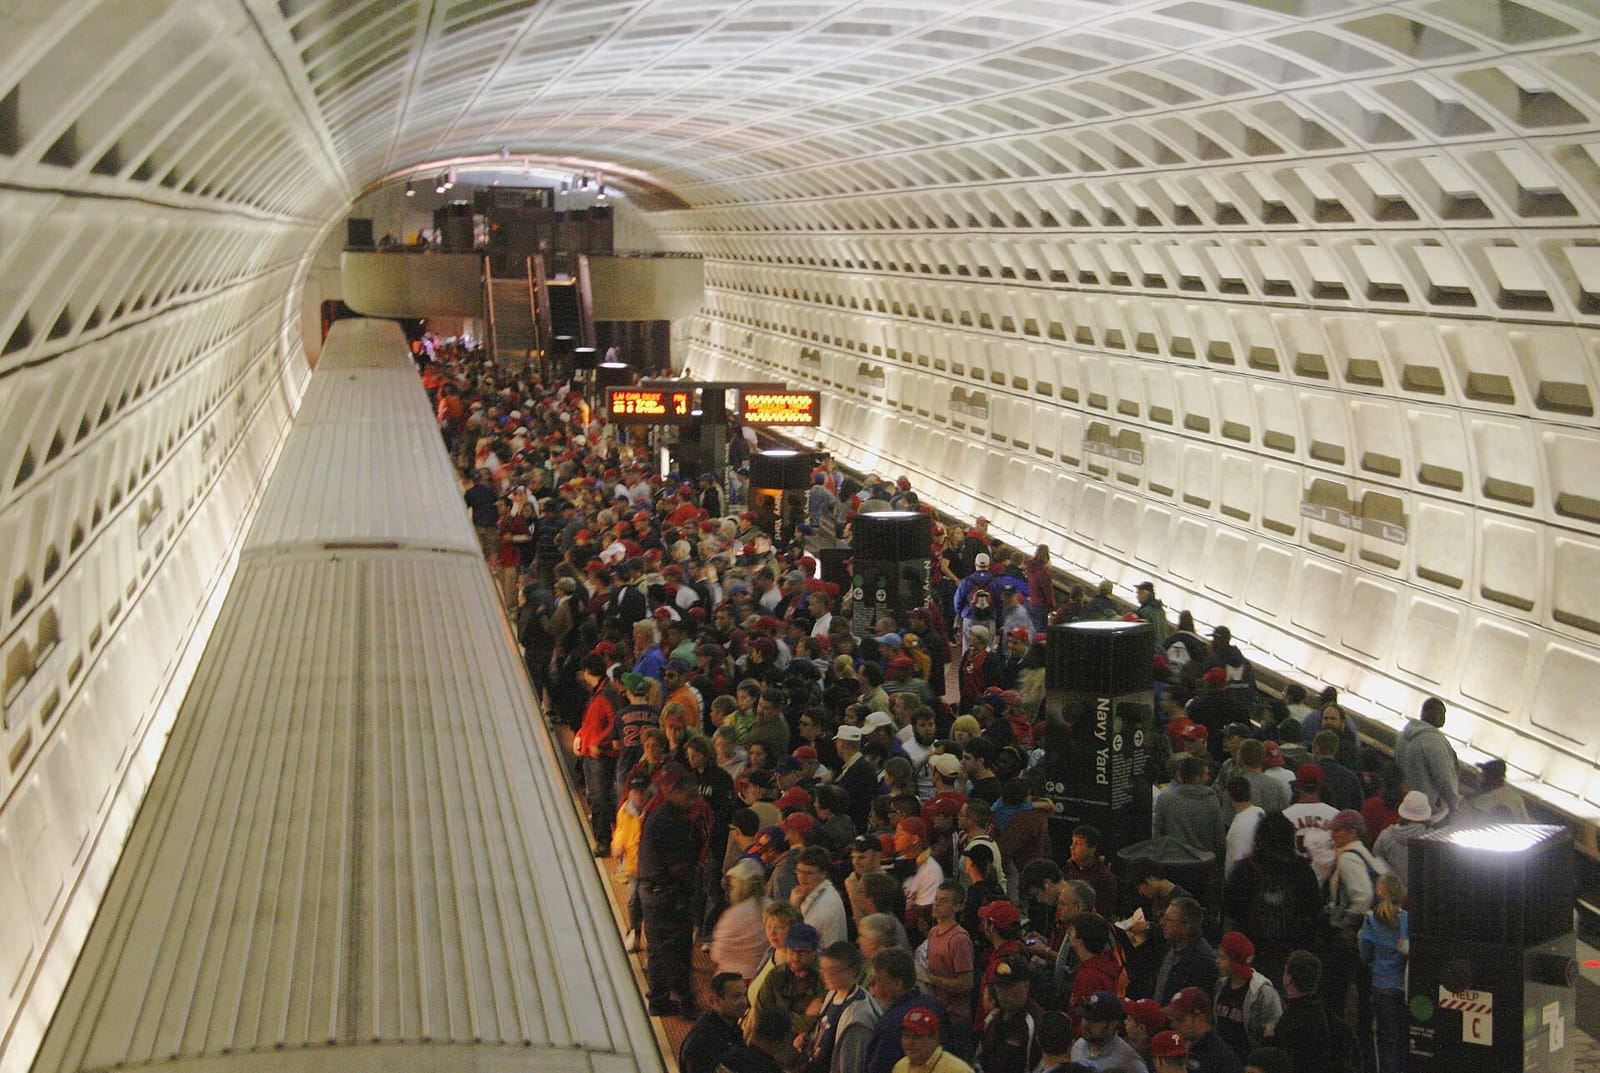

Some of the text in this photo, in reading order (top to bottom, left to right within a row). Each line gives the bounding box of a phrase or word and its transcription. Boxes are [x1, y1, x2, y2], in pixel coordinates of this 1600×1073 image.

[1094, 698, 1110, 784] Navy Yard
[1451, 991, 1480, 1001] HELP
